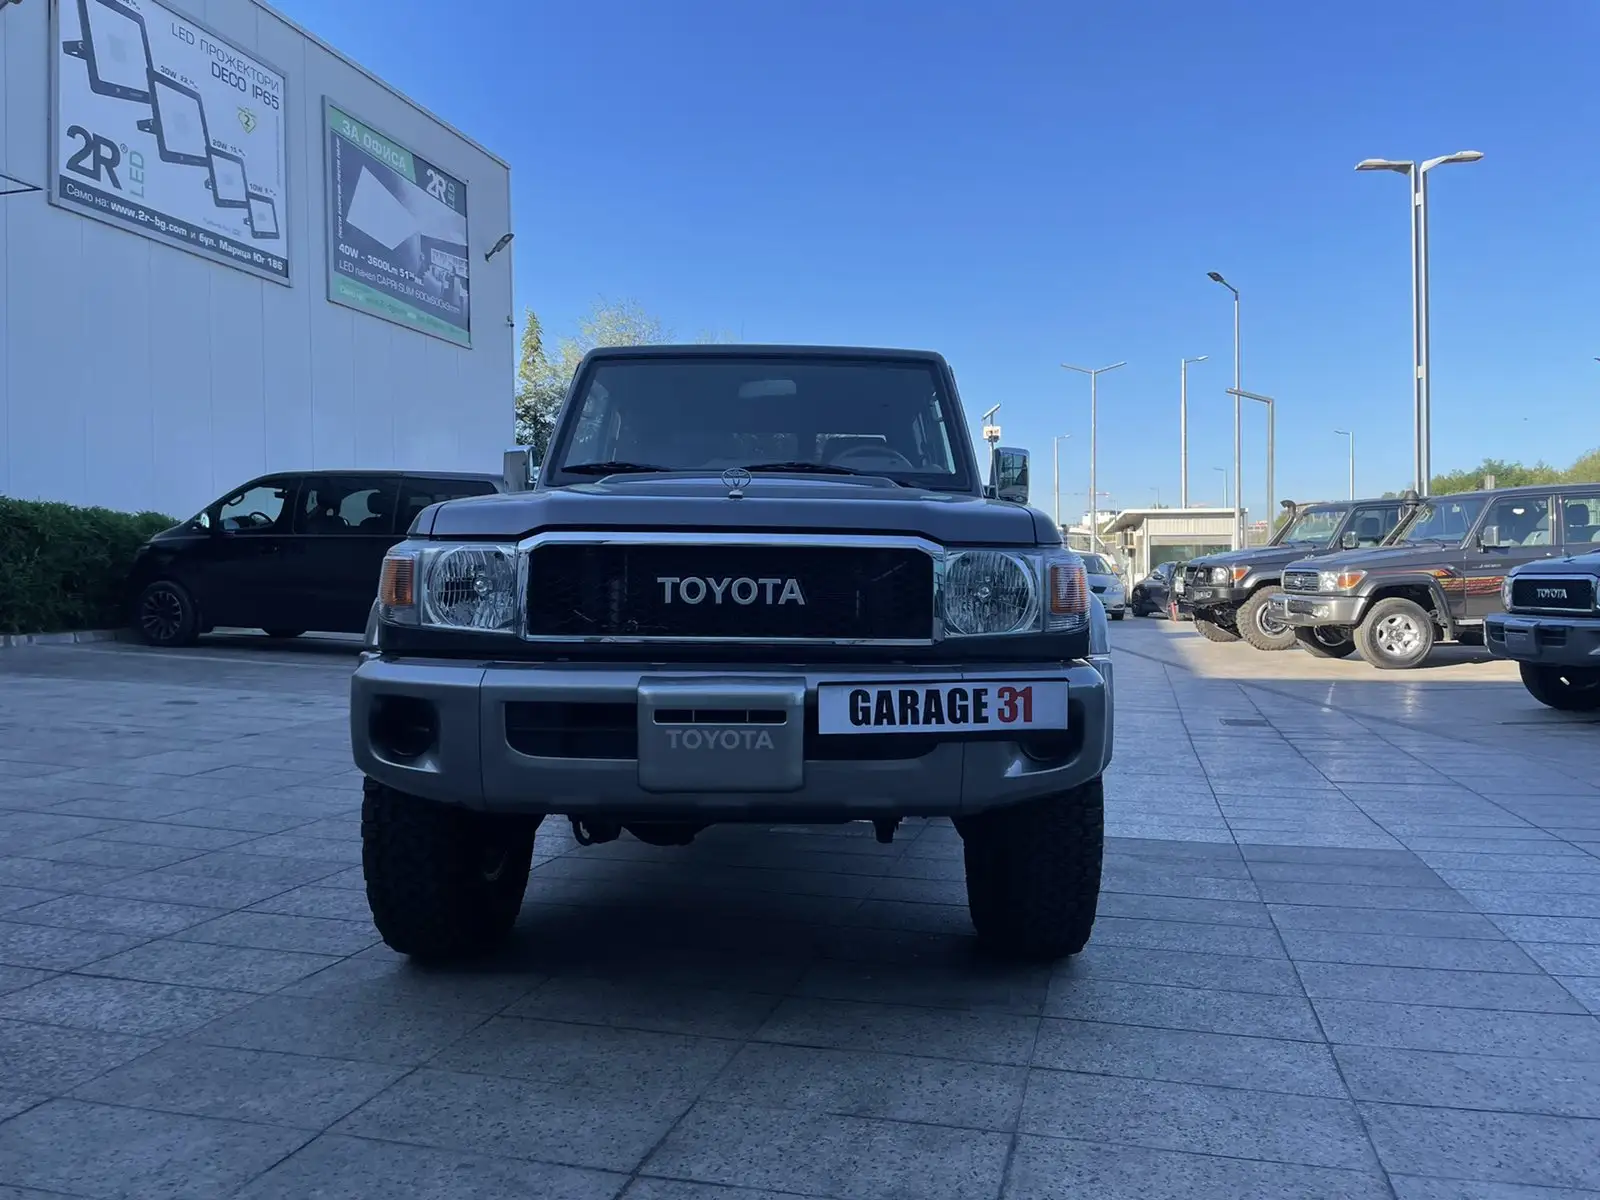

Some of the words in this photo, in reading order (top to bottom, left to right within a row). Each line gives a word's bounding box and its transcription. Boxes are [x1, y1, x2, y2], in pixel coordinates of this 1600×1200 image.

[171, 22, 195, 45] LED
[200, 38, 280, 93] ПРОЖЕКТОРИ
[211, 61, 247, 92] DECO
[252, 83, 280, 110] IP65
[341, 119, 361, 143] ЗА
[363, 132, 407, 172] ОФИСА
[129, 150, 145, 199] LED
[66, 183, 94, 202] Само
[110, 202, 188, 237] www.2r-bg.com
[339, 259, 355, 273] LED
[656, 576, 806, 606] TOYOTA
[1536, 588, 1568, 599] TOYOTA
[849, 687, 989, 726] GARAGE
[997, 685, 1034, 723] 31
[665, 729, 775, 750] TOYOTA
